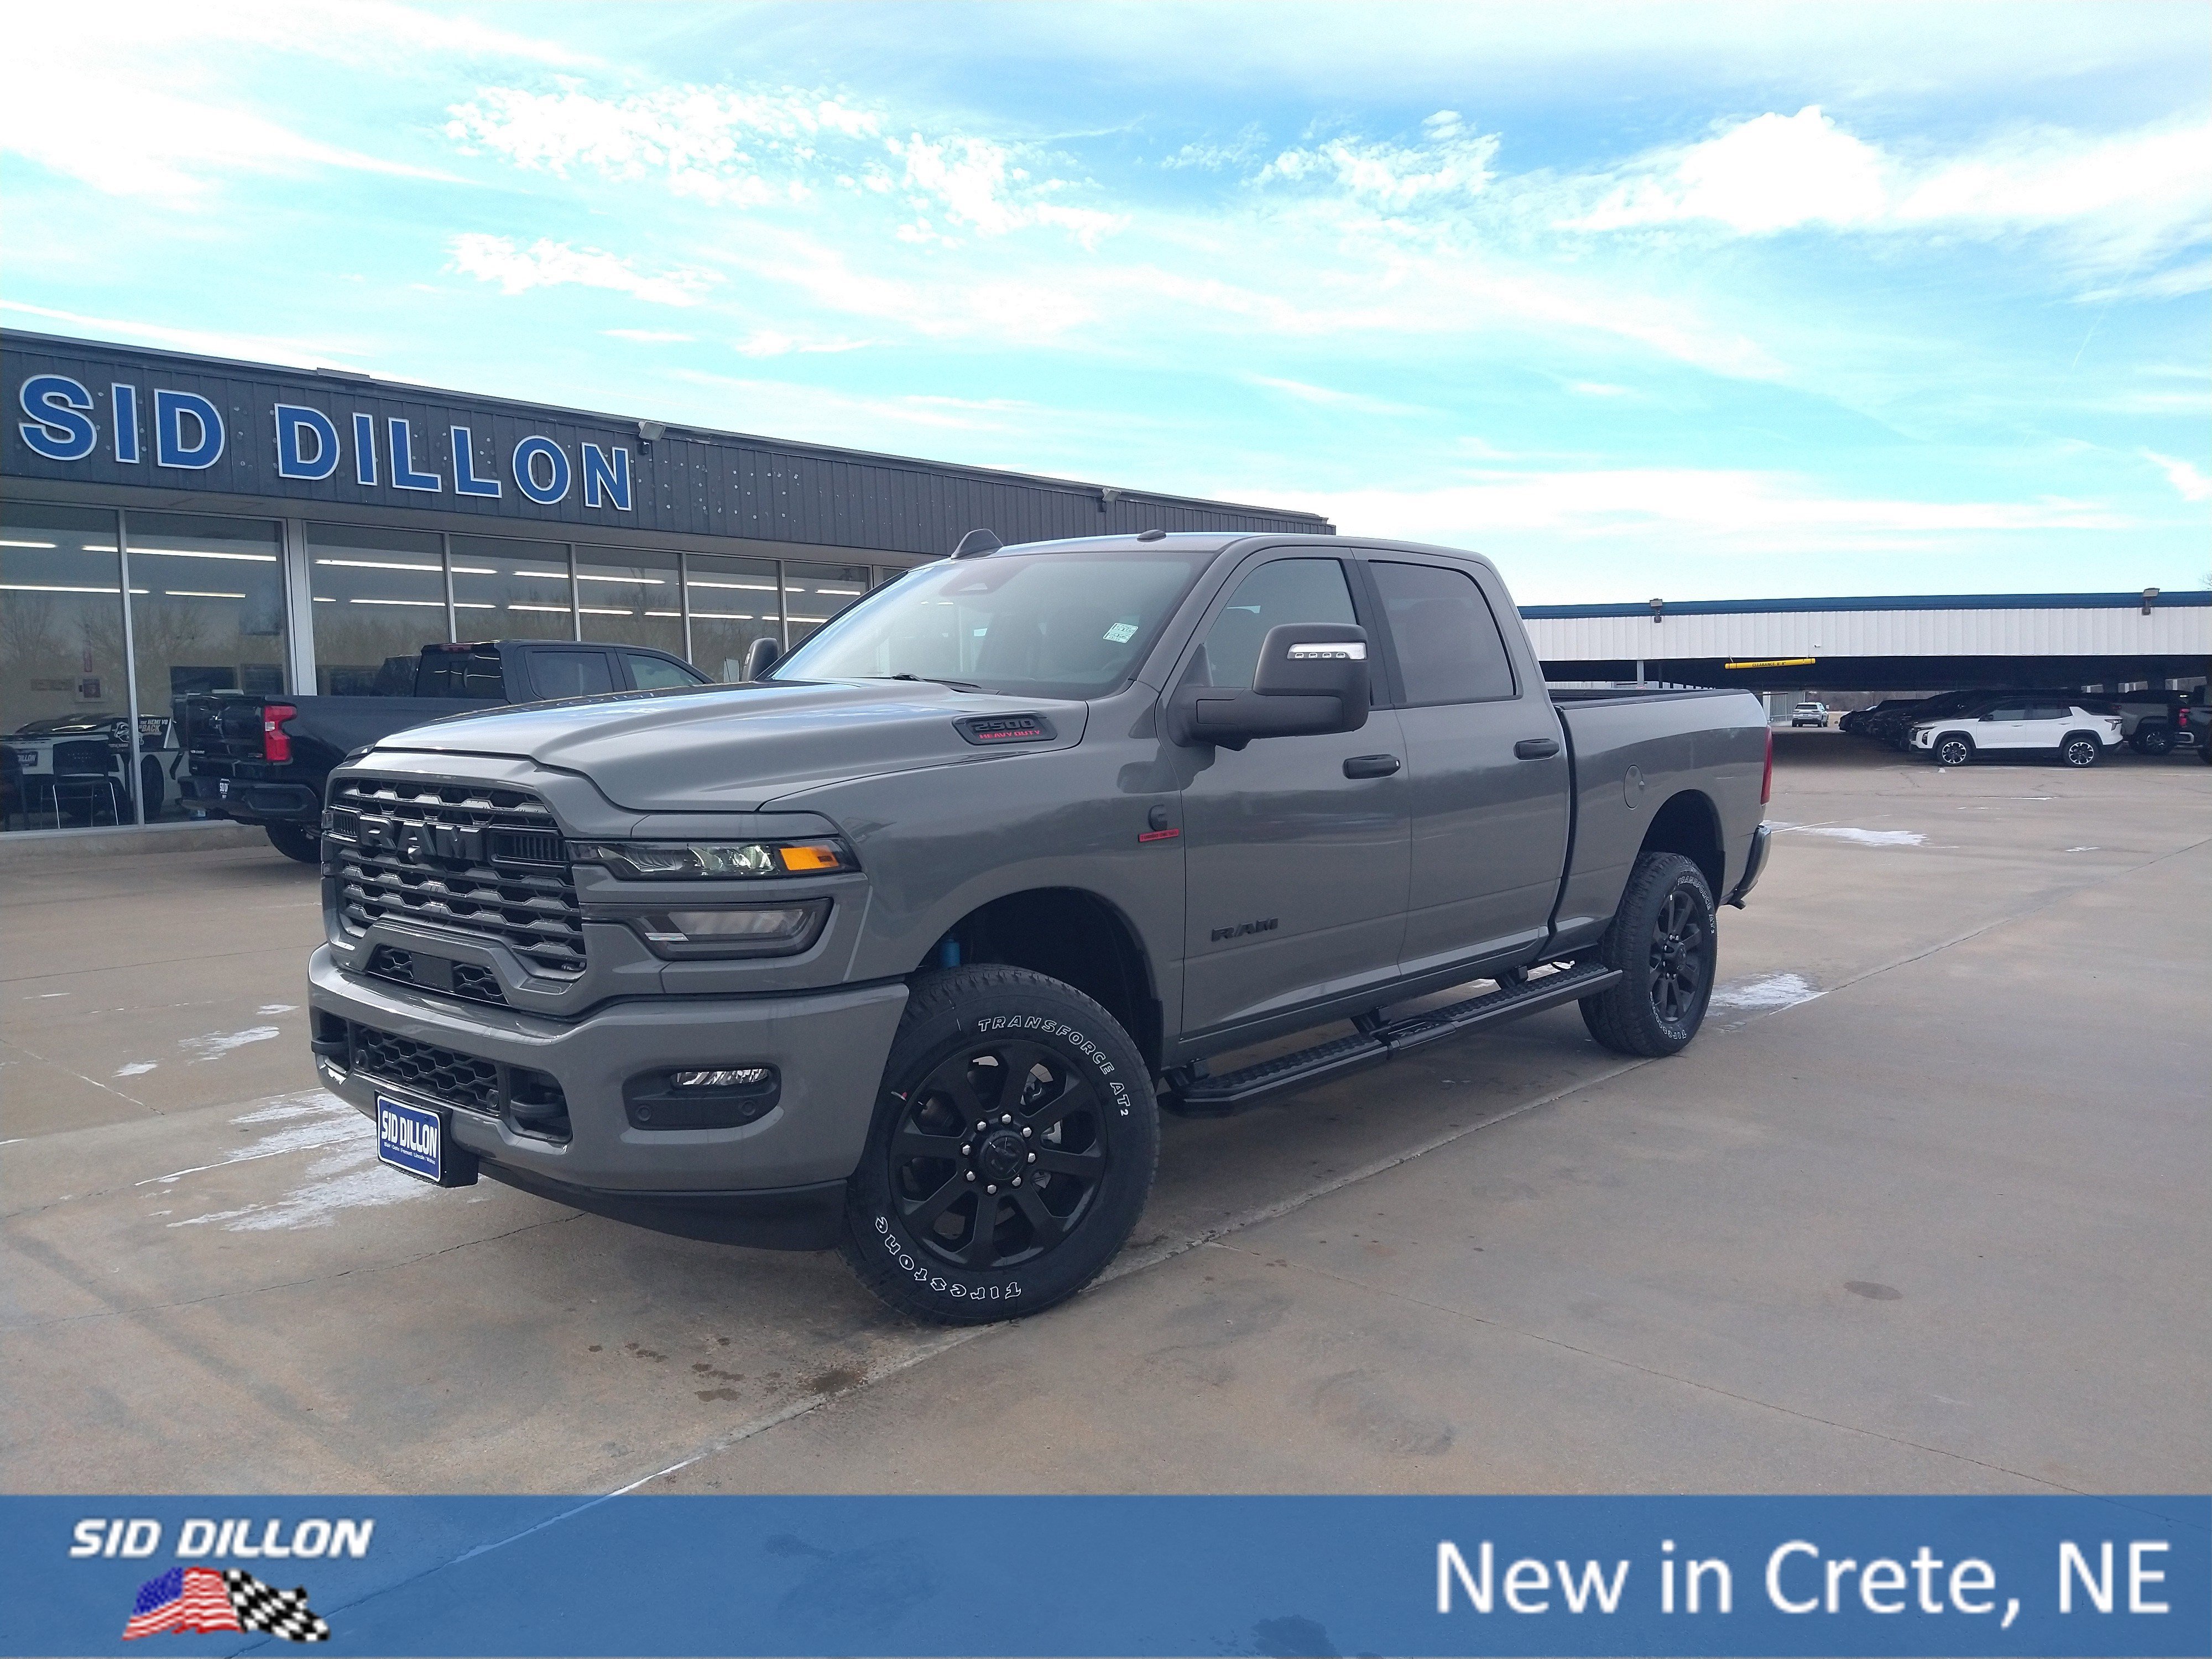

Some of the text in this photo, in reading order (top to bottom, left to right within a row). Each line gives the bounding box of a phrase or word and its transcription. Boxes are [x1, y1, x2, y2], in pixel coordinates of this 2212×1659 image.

[18, 373, 632, 512] SID DILLON
[973, 718, 1035, 733] 2500
[359, 815, 487, 862] RAM
[1211, 917, 1279, 942] RAM
[978, 1015, 1115, 1076] TRANSFORCE
[381, 1110, 437, 1159] SID DILLON
